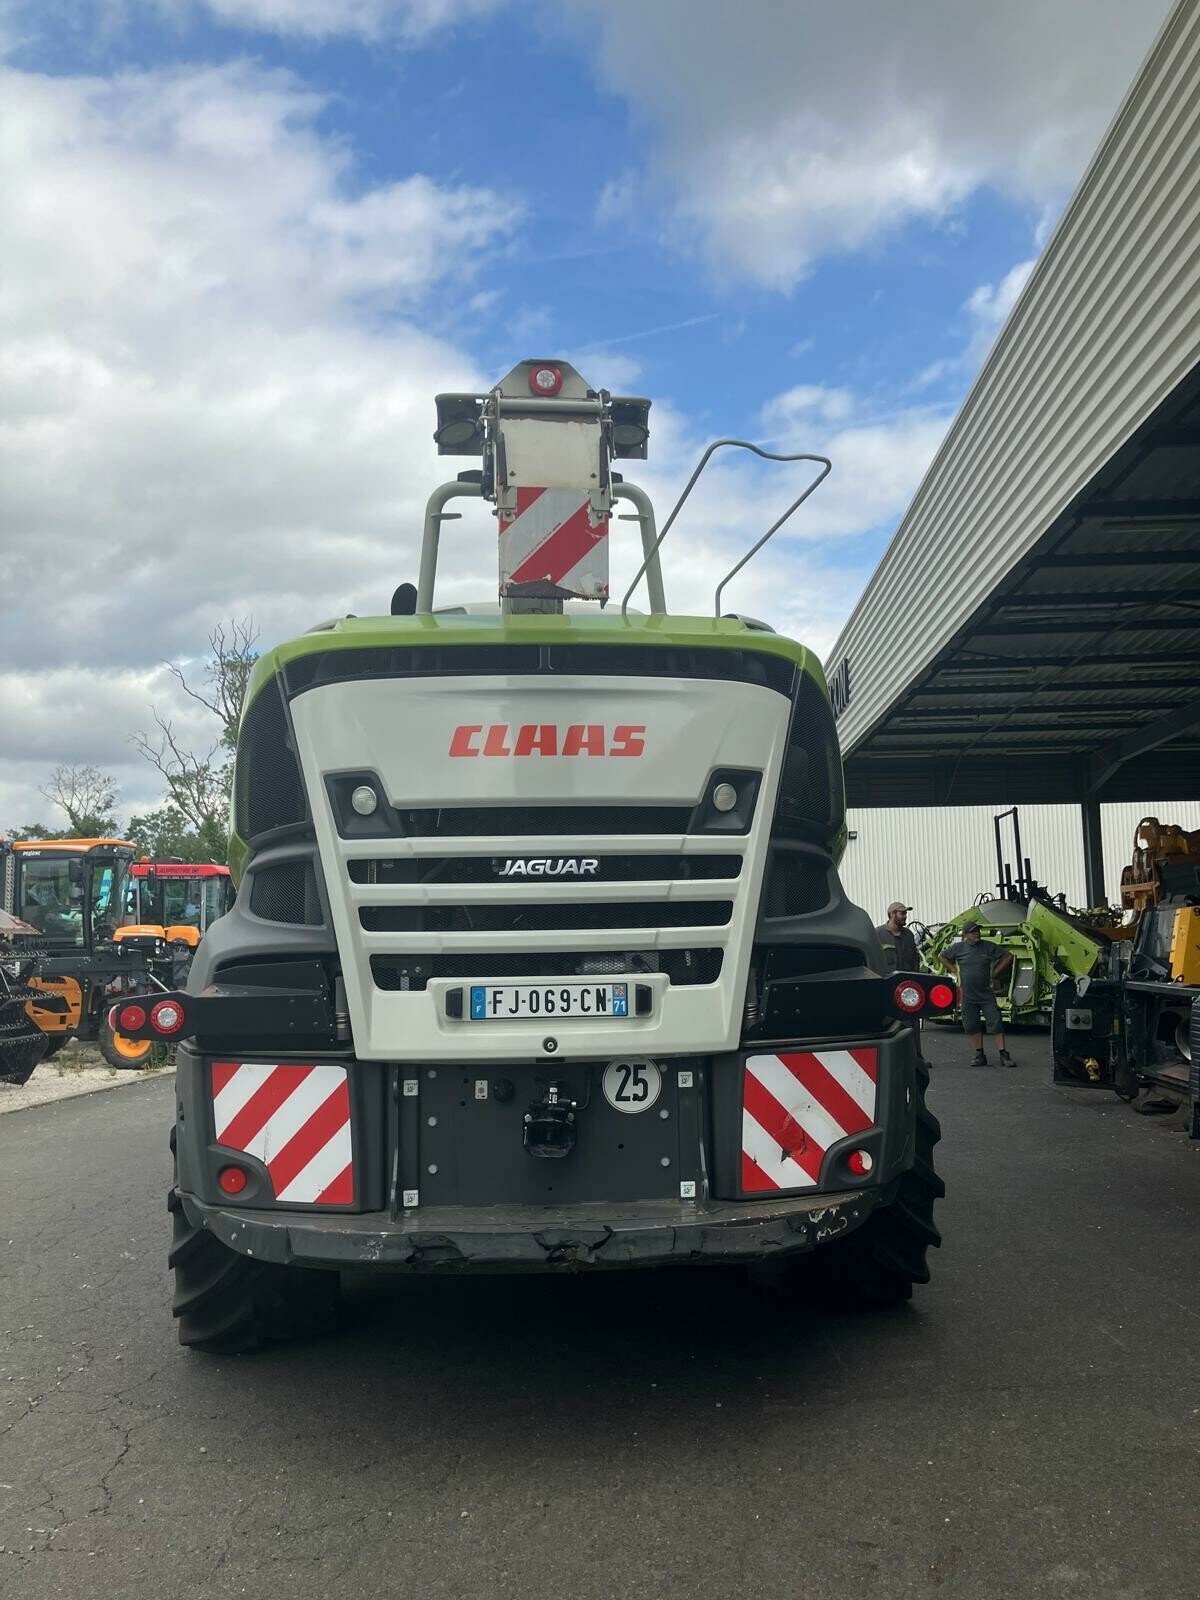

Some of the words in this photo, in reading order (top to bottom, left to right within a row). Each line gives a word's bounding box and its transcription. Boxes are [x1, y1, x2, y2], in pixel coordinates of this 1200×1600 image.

[448, 724, 646, 757] CLAAS
[499, 859, 598, 876] JAGUAR
[476, 1005, 481, 1013] F
[492, 988, 607, 1015] FJ-069-CN
[613, 1000, 626, 1012] 71
[615, 1064, 648, 1102] 25
